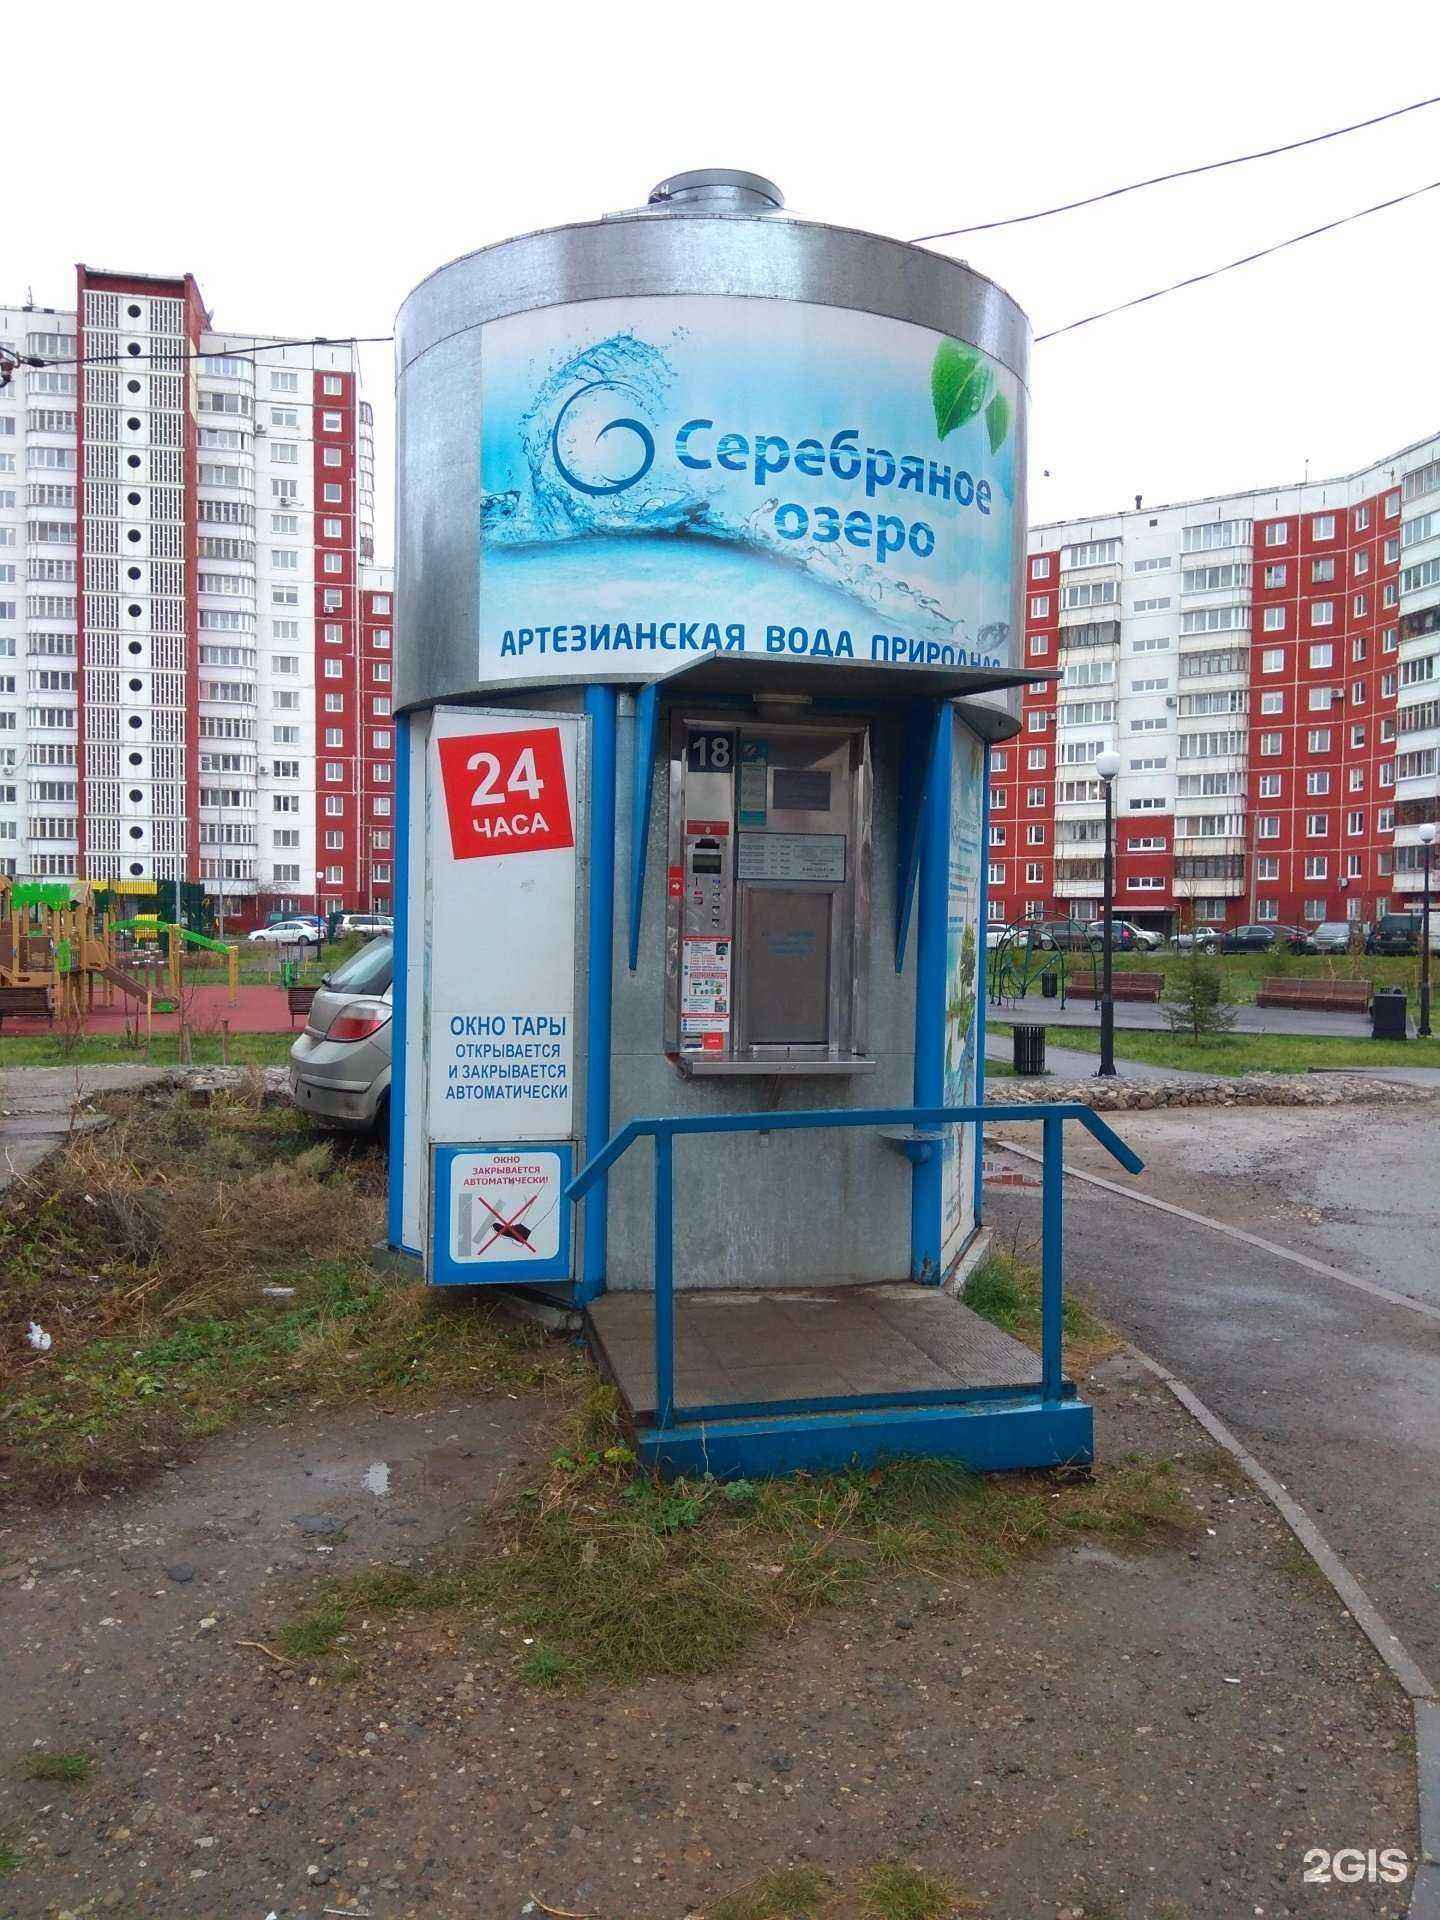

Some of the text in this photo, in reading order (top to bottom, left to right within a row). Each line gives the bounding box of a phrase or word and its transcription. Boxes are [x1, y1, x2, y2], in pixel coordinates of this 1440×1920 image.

[674, 418, 992, 515] Серебряное
[774, 502, 935, 564] озеро
[500, 622, 745, 656] АРТЕЗИАНСКАЯ
[766, 625, 854, 657] ВОДА
[693, 737, 730, 768] 18
[467, 747, 545, 806] 24
[472, 812, 550, 838] ЧАСА
[450, 1016, 566, 1035] ОКНО ТАРЫ
[455, 1044, 560, 1058] ОТКРЫВАЕТСЯ
[448, 1064, 566, 1078] И ЗАКРЫВАЕТСЯ
[446, 1085, 568, 1099] АВТОМАТИЧЕСКИ
[493, 1156, 520, 1164] ОКНО
[472, 1166, 541, 1175] ЗАКРЫВАЕТСЯ
[463, 1176, 549, 1186] АВТОМАТИЧЕСКИ!
